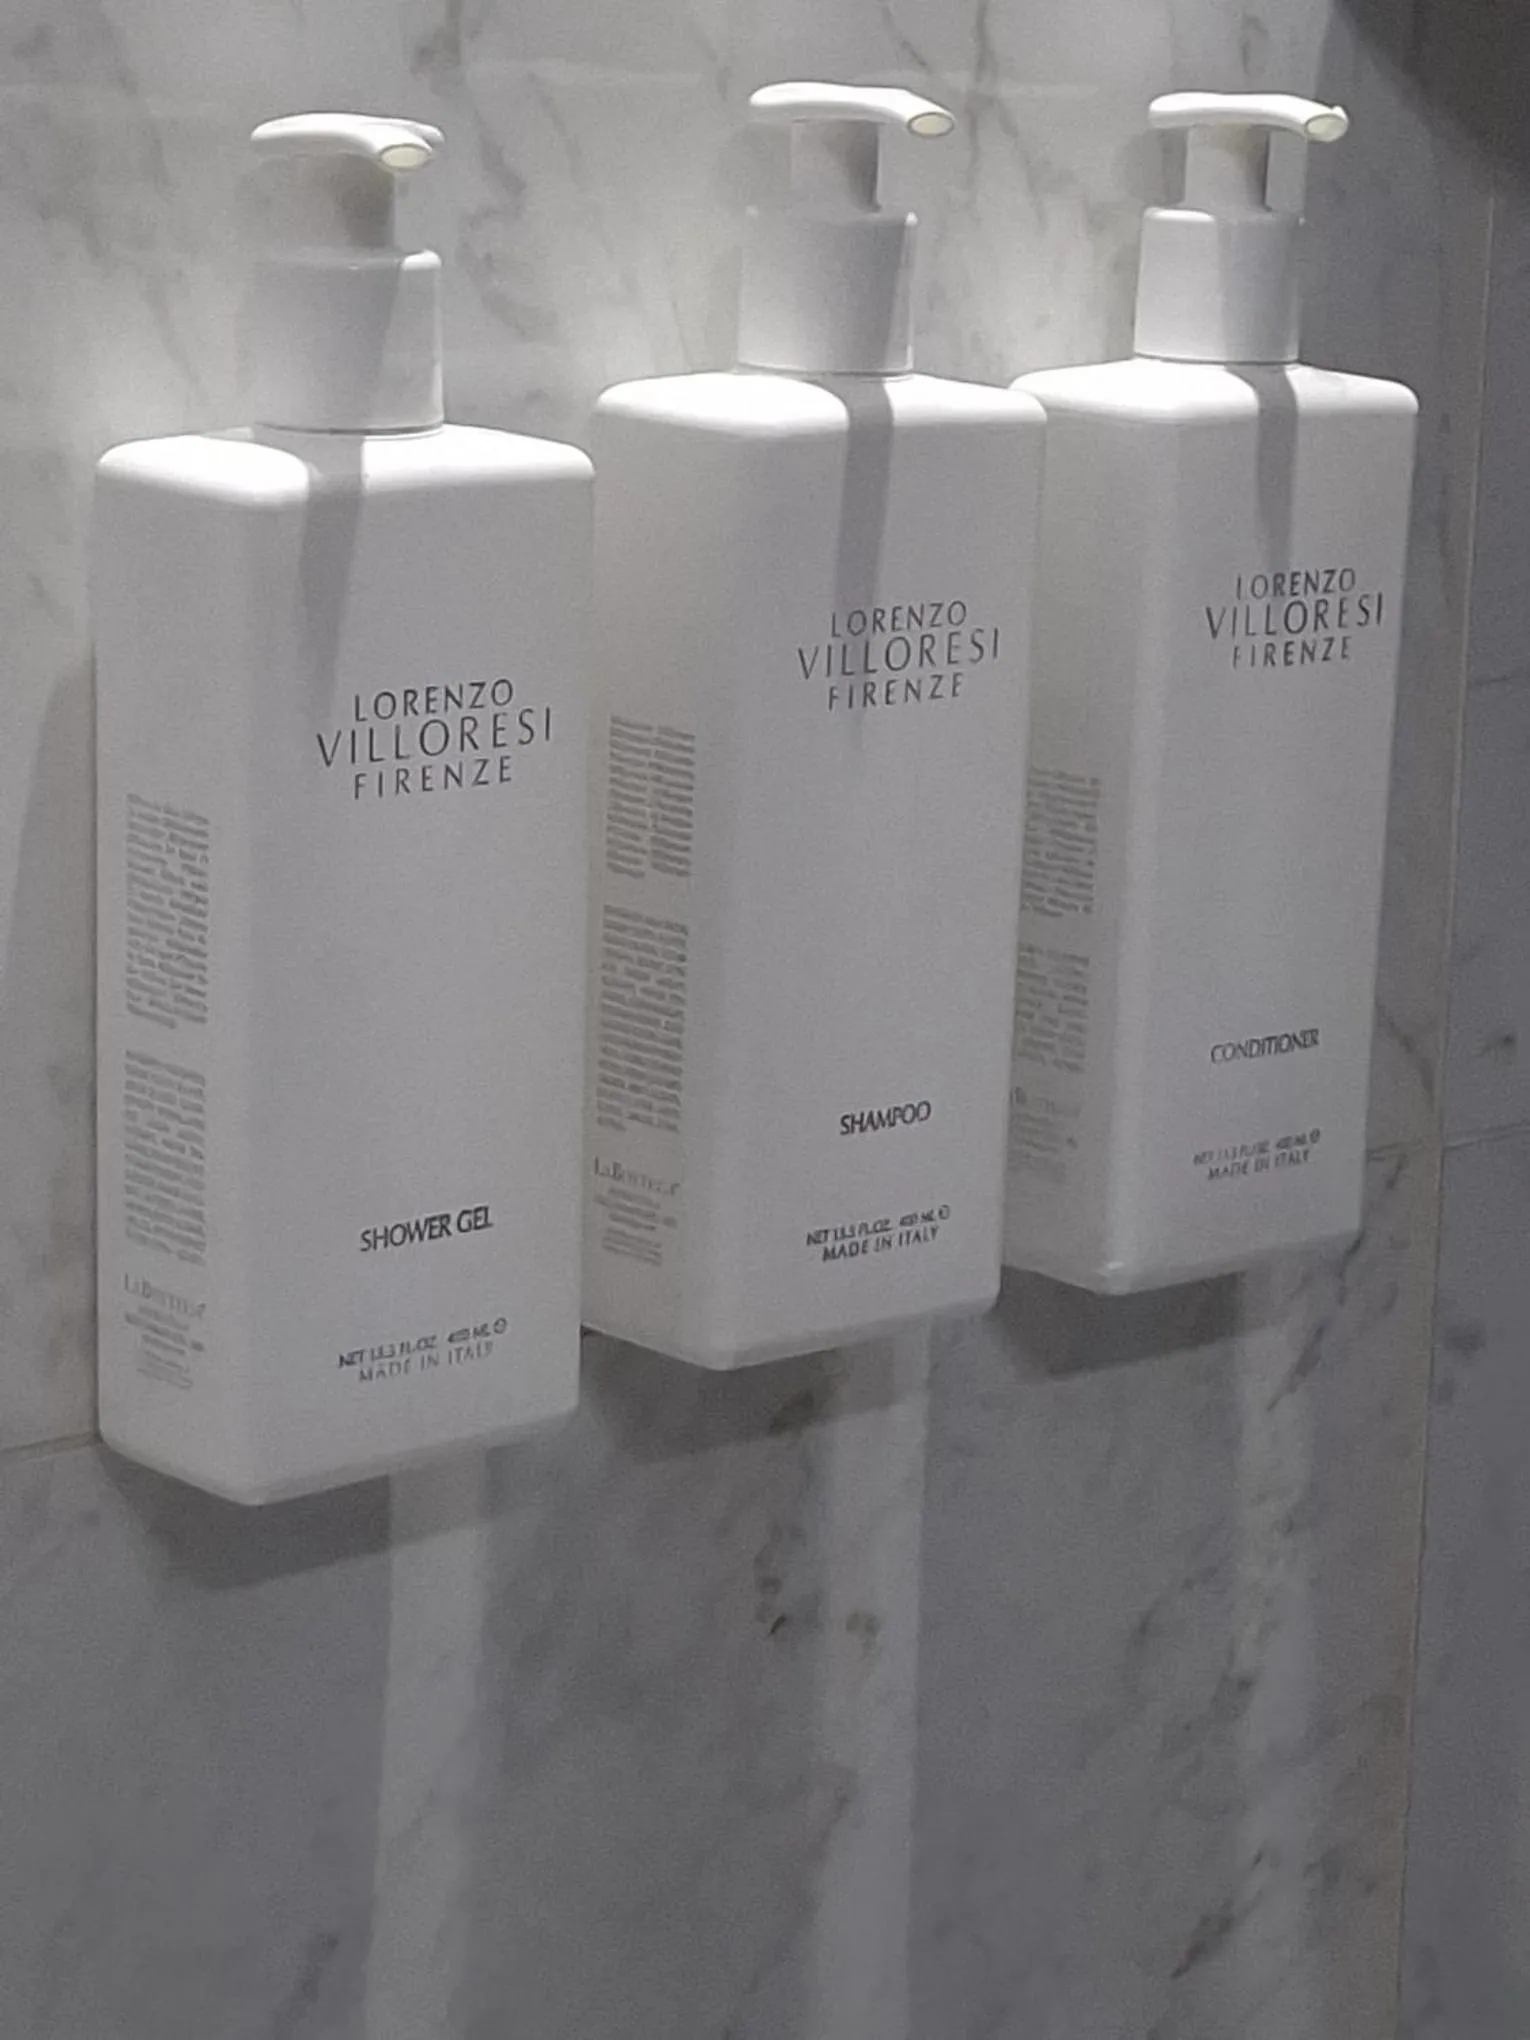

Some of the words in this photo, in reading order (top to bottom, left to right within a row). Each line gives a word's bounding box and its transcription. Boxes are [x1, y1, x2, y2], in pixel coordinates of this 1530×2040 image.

[1237, 568, 1356, 600] LORENZO
[832, 601, 966, 638] LORENZO
[1205, 592, 1383, 639] VILLORESI
[798, 628, 998, 680] VILLORESI
[1233, 636, 1352, 669] FIRENZE
[355, 678, 513, 722] LORENZO
[829, 672, 964, 711] FIRENZE
[316, 706, 550, 767] VILLORESI
[354, 756, 512, 800] FIRENZE
[1210, 1028, 1319, 1064] CONDITIONER
[840, 1100, 931, 1136] SHAMPOO
[360, 1213, 452, 1252] SHOWER
[457, 1205, 494, 1233] GEL
[823, 1239, 868, 1262] MADE
[875, 1236, 892, 1252] IN
[898, 1226, 939, 1247] ITALY
[359, 1358, 411, 1382] MADE
[420, 1353, 440, 1372] IN
[449, 1341, 494, 1366] ITALY
